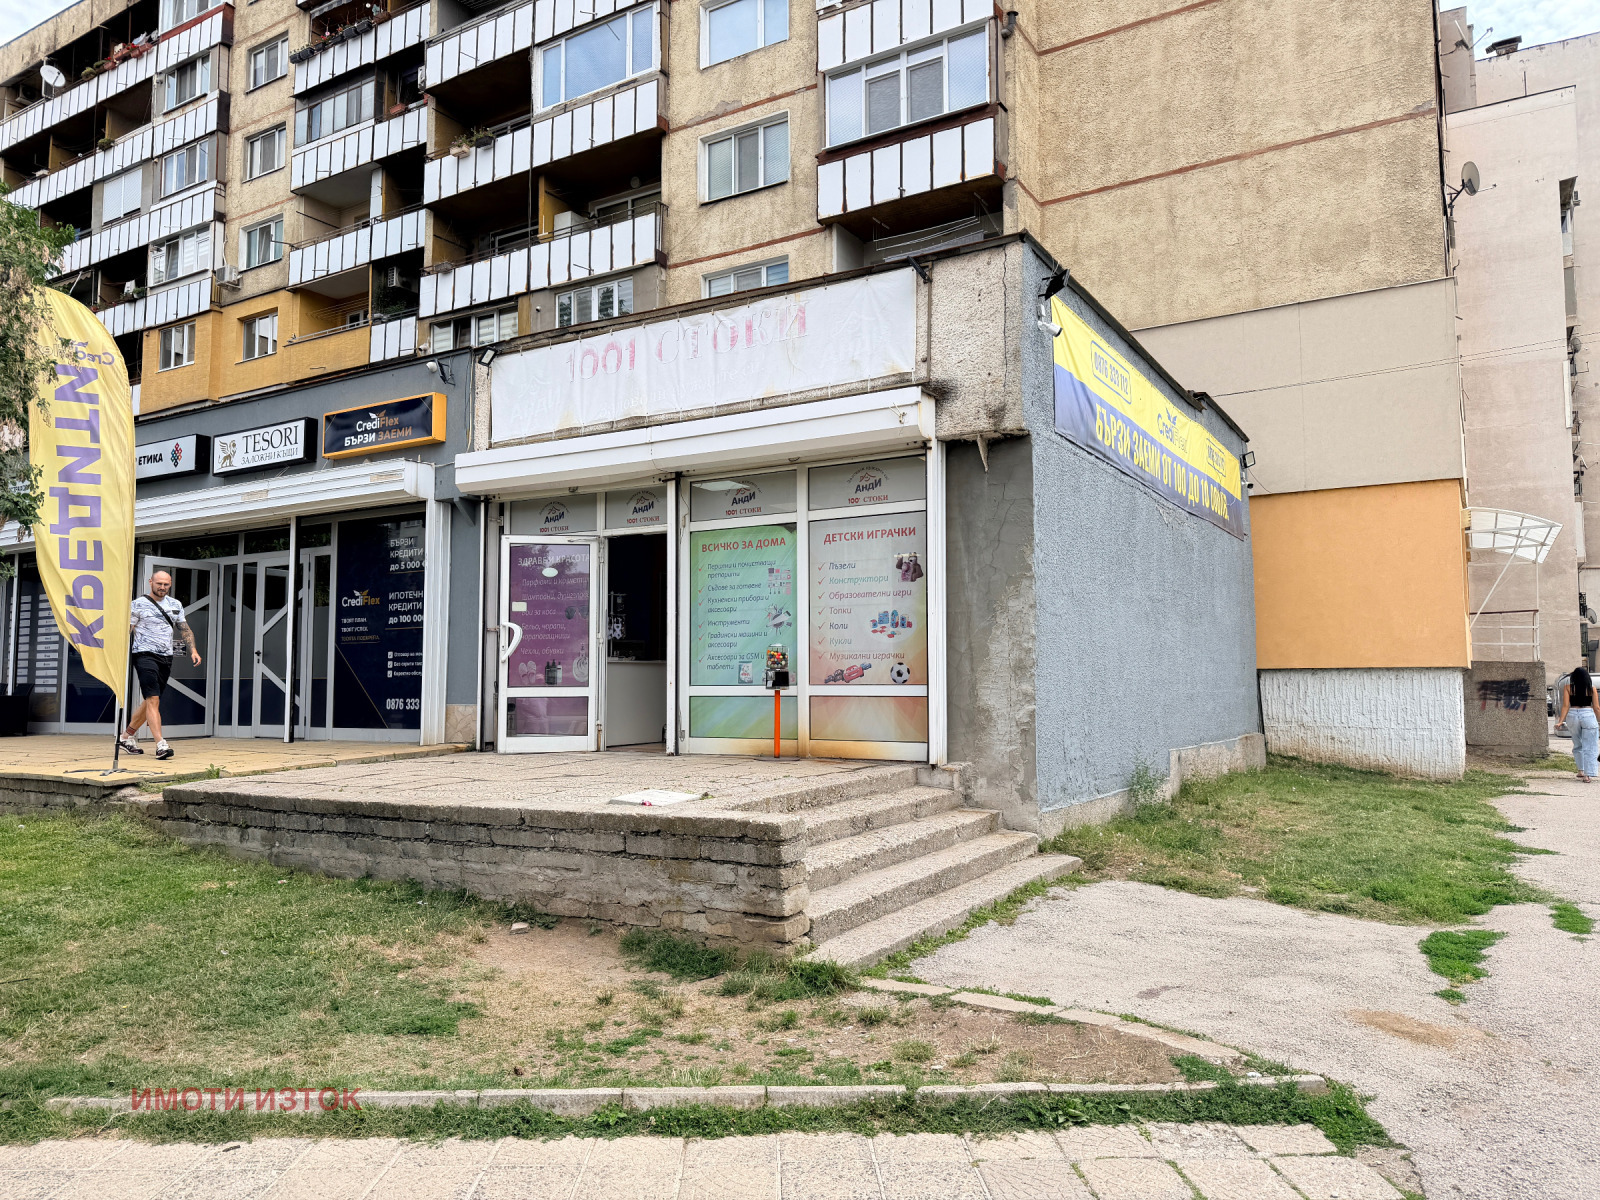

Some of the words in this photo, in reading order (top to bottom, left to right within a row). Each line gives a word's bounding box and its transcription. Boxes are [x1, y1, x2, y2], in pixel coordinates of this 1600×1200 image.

[566, 338, 636, 382] 1001
[657, 301, 809, 364] СТОКИ
[356, 416, 399, 432] CrediFlex
[242, 425, 299, 454] TESORI
[344, 432, 376, 447] БЪРЗИ
[378, 426, 412, 441] ЗАЕМИ
[241, 450, 276, 465] ЗАЛОЖНИ
[276, 447, 298, 462] КЪЩИ
[1095, 403, 1131, 461] БЪРЗИ
[1133, 432, 1161, 486] ЗАЕМИ
[1162, 454, 1173, 488] ОТ
[1173, 462, 1186, 497] 100
[1188, 471, 1200, 507] ДО
[855, 478, 882, 494] АндИ
[731, 491, 756, 506] АндИ
[863, 494, 889, 502] СТОКИ
[632, 500, 654, 515] АндИ
[740, 506, 762, 514] СТОКИ
[544, 511, 565, 524] АндИ
[824, 530, 864, 546] ДЕТСКИ
[867, 526, 916, 540] ИГРАЧКИ
[390, 538, 414, 548] БЪРЗИ
[702, 541, 739, 552] ВСИЧКО
[741, 539, 754, 550] ЗА
[756, 536, 786, 551] ДОМА
[390, 548, 424, 558] КРЕДИТИ
[390, 564, 400, 572] до
[400, 562, 406, 570] 5
[406, 560, 420, 569] 000
[518, 556, 546, 567] ЗДРАВЕ
[828, 562, 856, 570] Пъзели
[828, 574, 889, 586] Конструктори
[342, 595, 380, 607] CrediFlex
[828, 590, 891, 601] Образователни
[892, 589, 912, 598] игри
[388, 602, 422, 612] КРЕДИТИ
[830, 606, 852, 614] Топки
[388, 616, 398, 624] до
[400, 614, 412, 623] 100
[830, 622, 848, 630] Коли
[830, 638, 852, 646] Кукли
[746, 652, 760, 660] GSM
[828, 652, 871, 661] Музикални
[872, 652, 905, 662] играчки
[386, 698, 404, 710] 0876
[406, 698, 420, 710] 333
